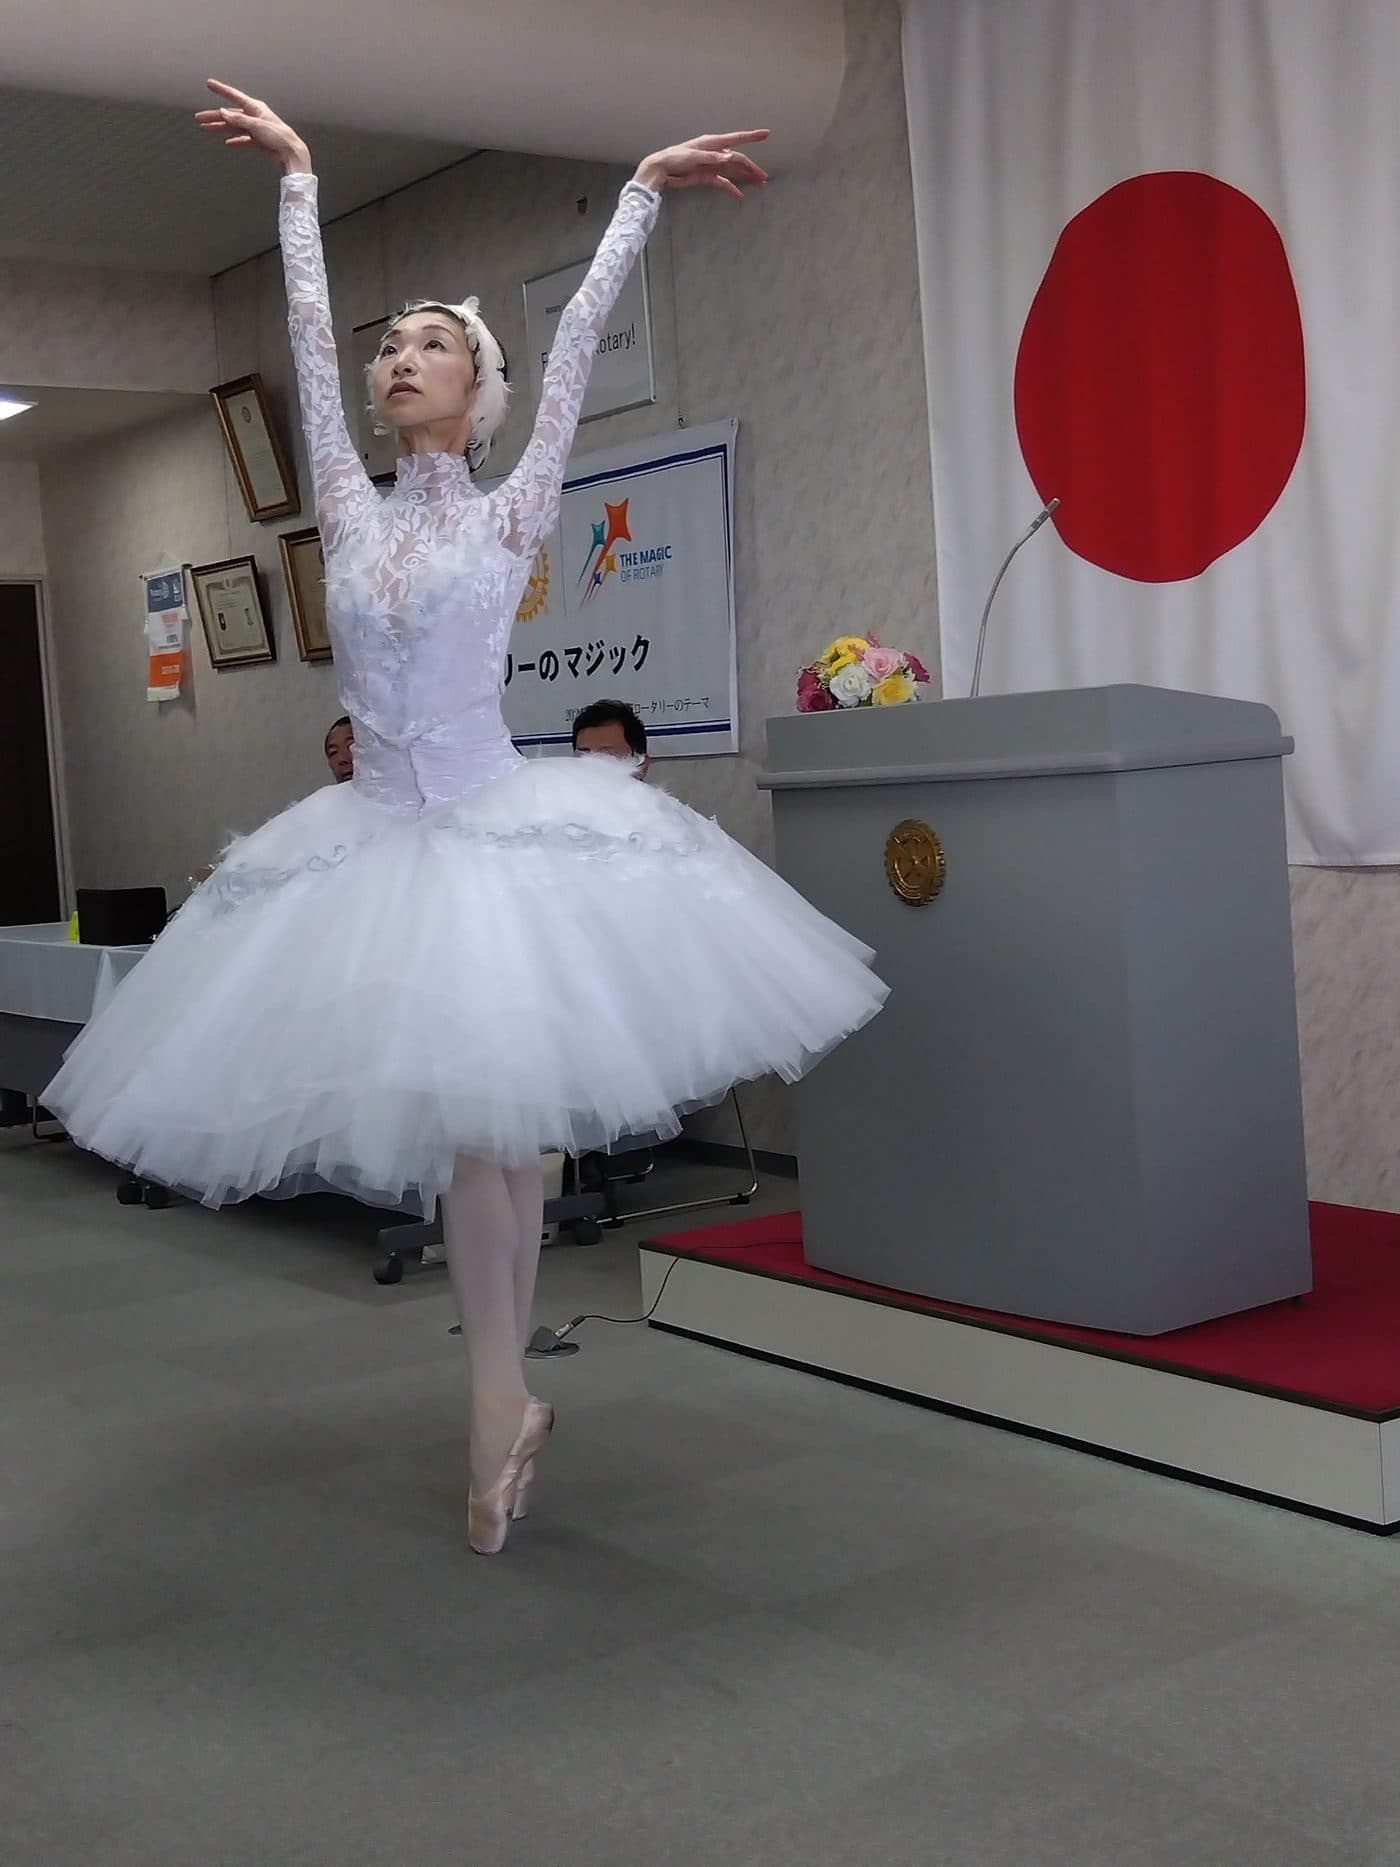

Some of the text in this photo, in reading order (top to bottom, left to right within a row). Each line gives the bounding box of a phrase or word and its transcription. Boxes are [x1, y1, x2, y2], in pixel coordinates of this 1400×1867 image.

[595, 322, 636, 356] otary!
[619, 545, 672, 567] THE MAGIC
[620, 563, 664, 583] OF ROTARY
